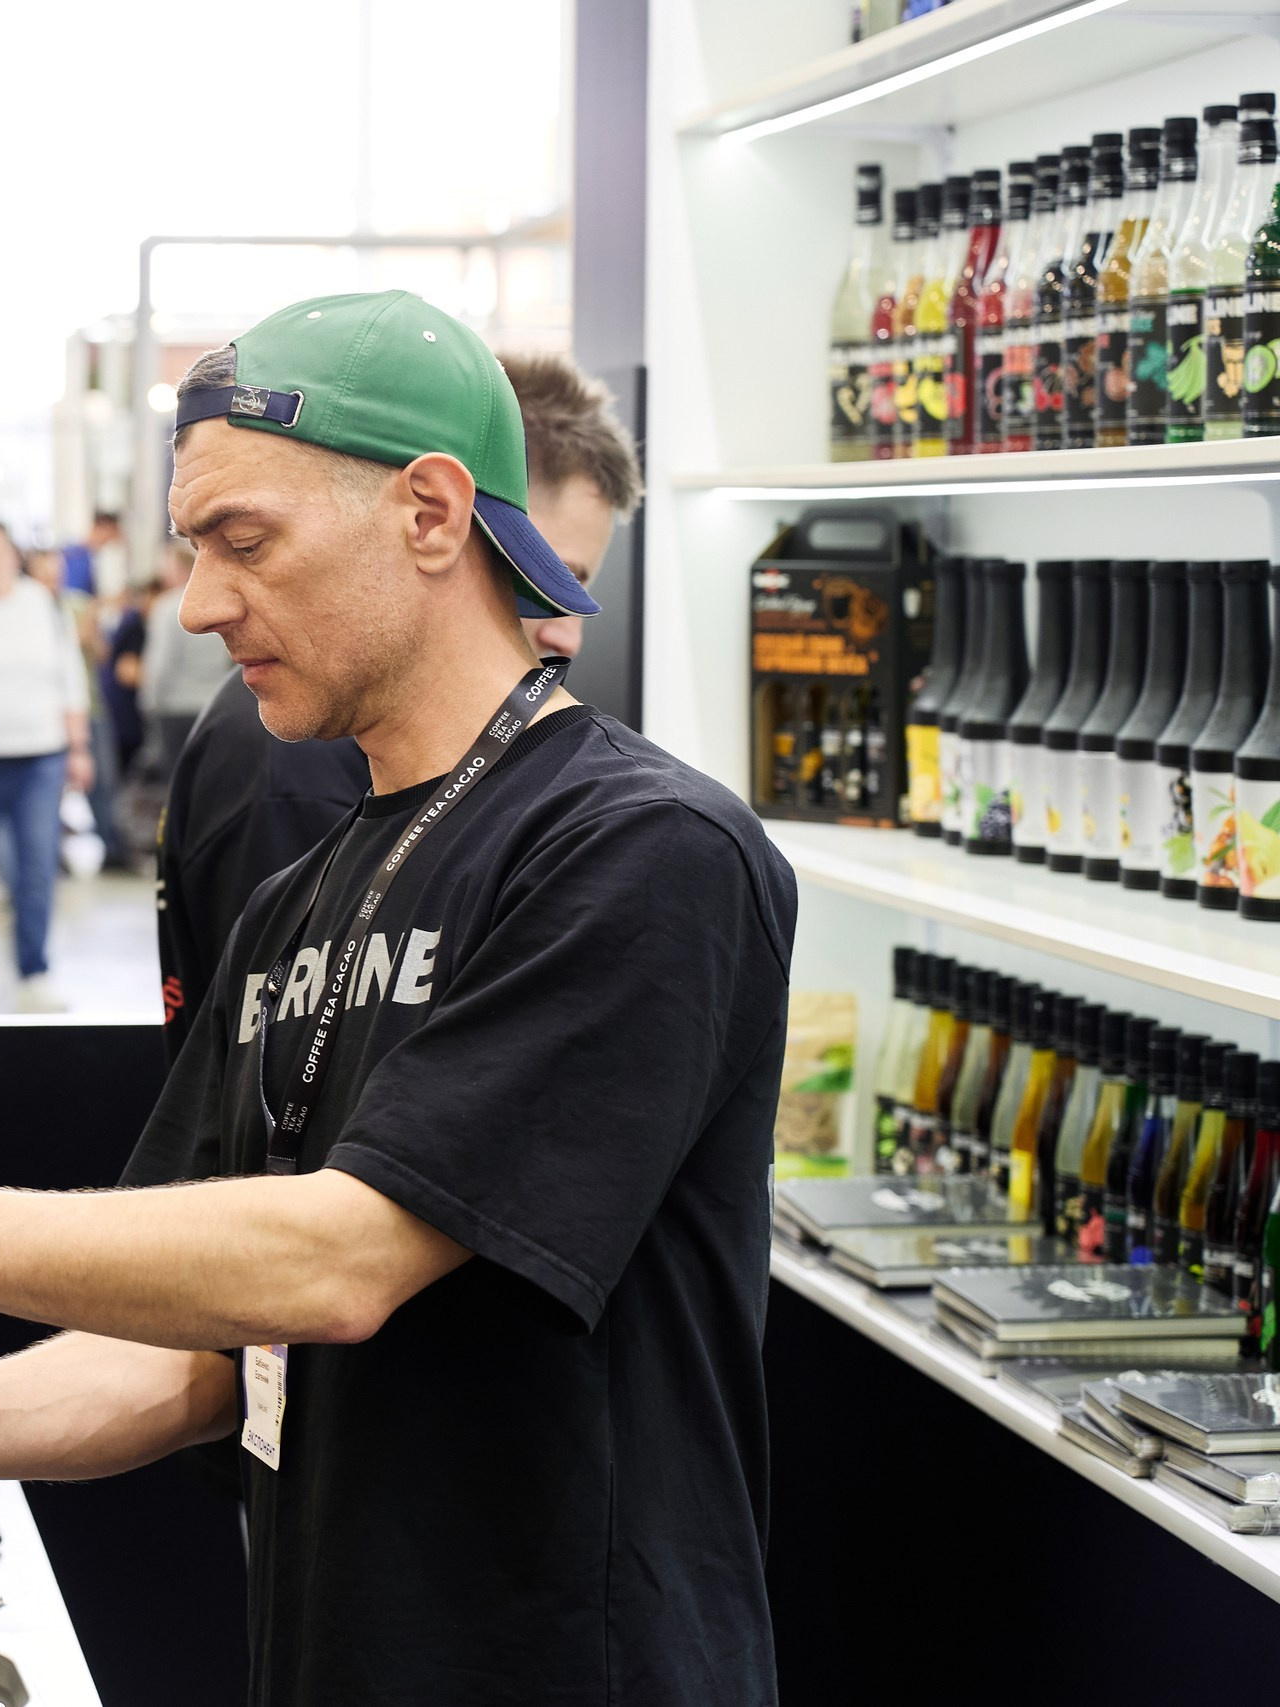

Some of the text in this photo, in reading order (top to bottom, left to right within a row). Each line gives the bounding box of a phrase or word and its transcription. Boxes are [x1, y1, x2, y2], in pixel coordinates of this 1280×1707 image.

[525, 666, 557, 702] COFFEE
[488, 710, 511, 736] COFFEE
[494, 724, 509, 739] TEA
[500, 720, 522, 744] CACAO
[386, 757, 486, 872] COFFEE TEA CACAO
[237, 926, 442, 1044] BRLINE
[302, 940, 356, 1083] COFFEE TEA CACAO
[281, 1101, 294, 1130] COFFEE
[287, 1116, 297, 1130] TEA
[294, 1106, 308, 1133] CACAO
